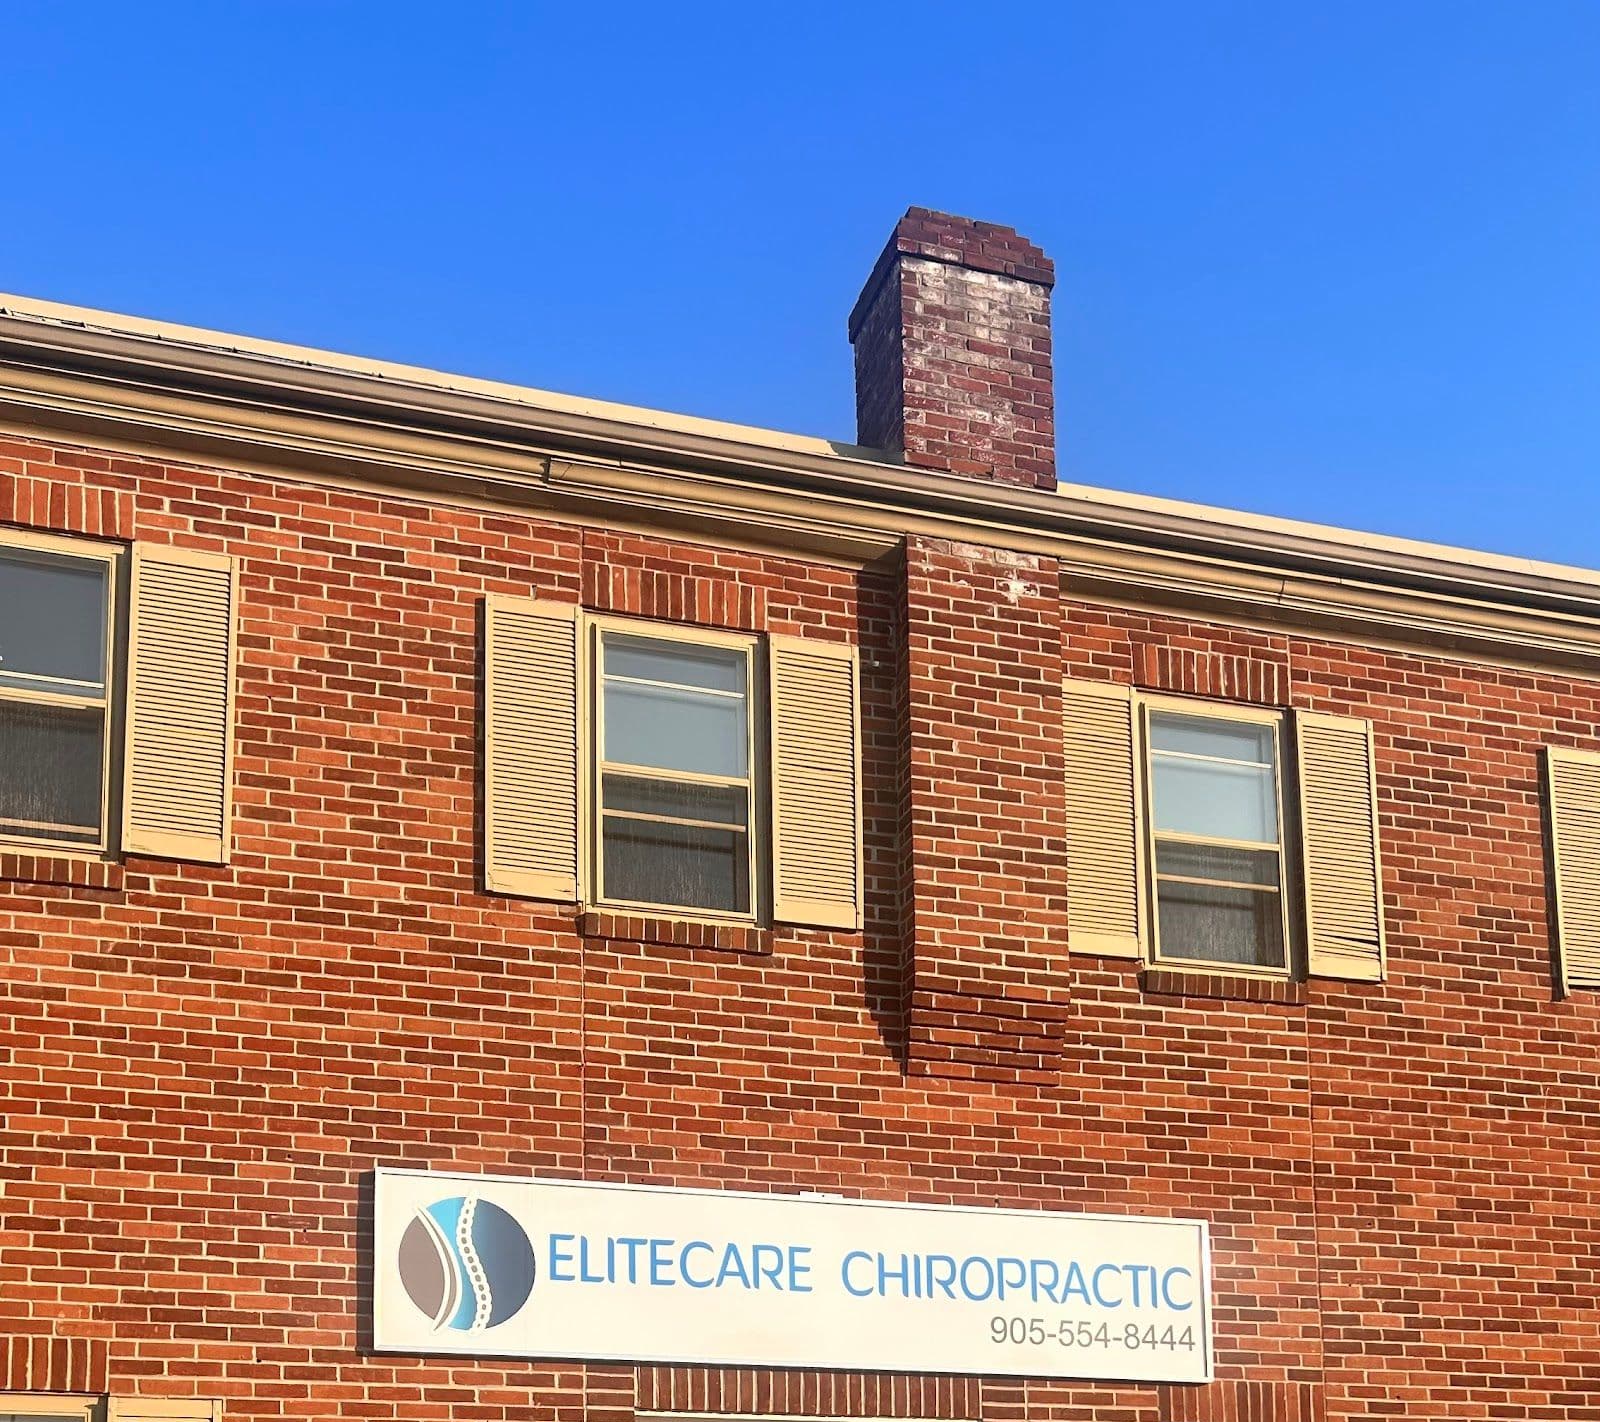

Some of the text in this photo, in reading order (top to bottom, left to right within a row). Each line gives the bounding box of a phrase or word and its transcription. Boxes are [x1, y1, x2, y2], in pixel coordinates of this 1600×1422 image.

[548, 1233, 1195, 1313] ELITECARE CHIROPRACTIC
[989, 1315, 1197, 1353] 905-554-8444
